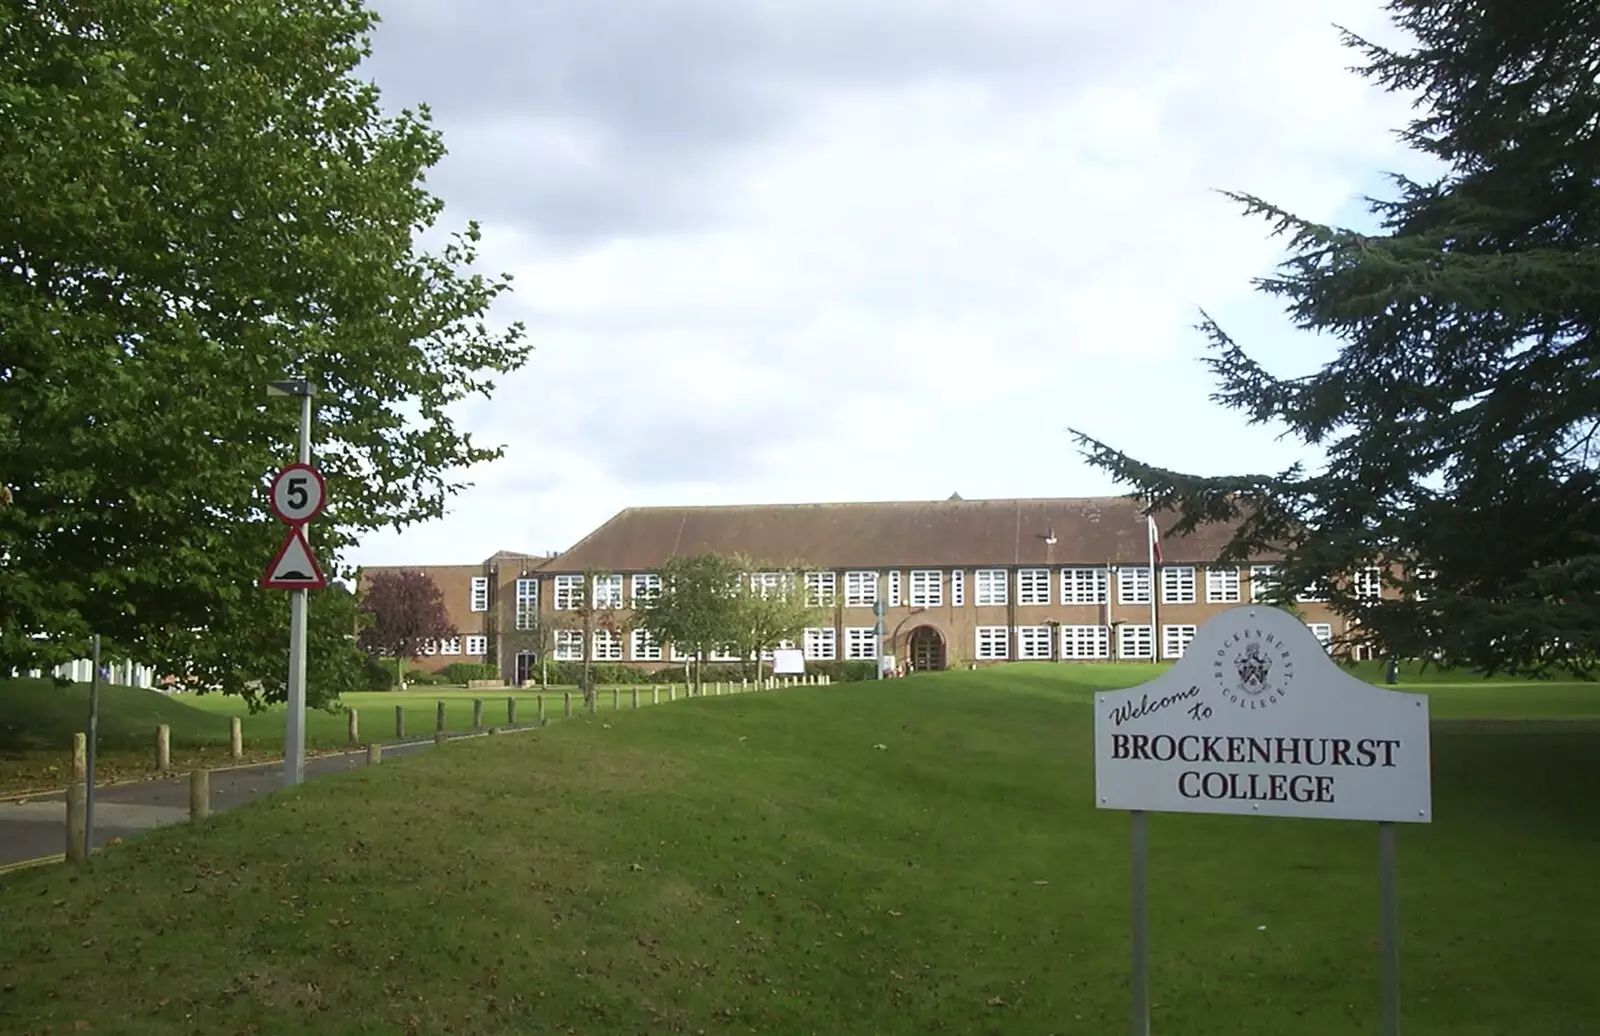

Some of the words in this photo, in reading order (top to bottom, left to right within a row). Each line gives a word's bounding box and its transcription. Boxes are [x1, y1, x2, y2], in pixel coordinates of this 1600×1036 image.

[287, 478, 308, 510] 5
[1214, 629, 1293, 678] BROCKENHURST
[1109, 685, 1200, 726] Welcome
[1187, 702, 1213, 721] to
[1222, 688, 1286, 710] COLLEGE
[1111, 733, 1400, 767] BROCKENHURST
[1178, 771, 1335, 803] COLLEGE
